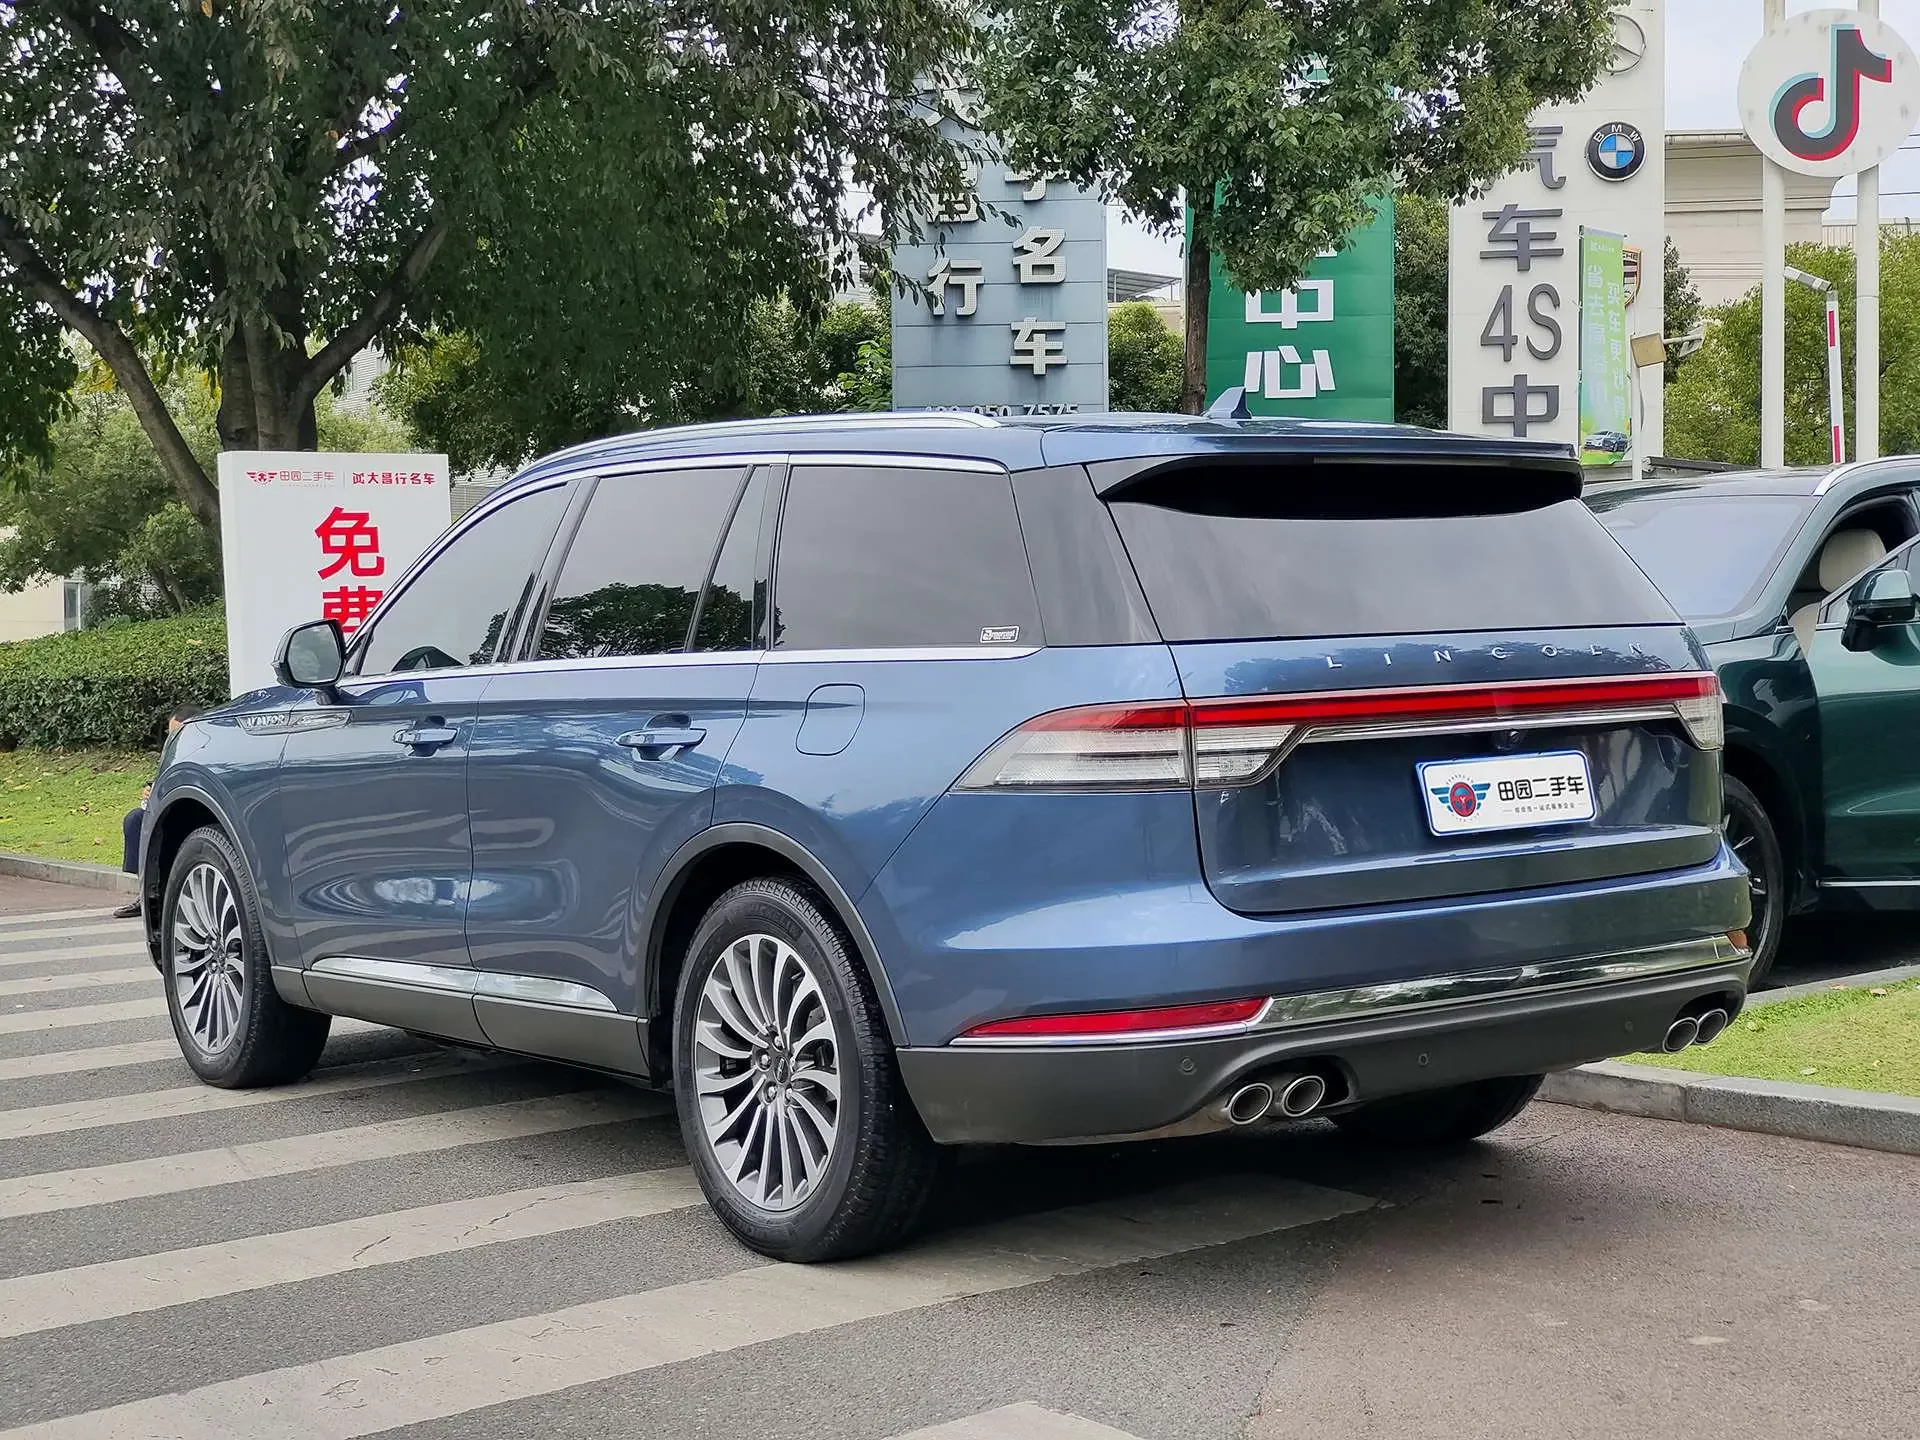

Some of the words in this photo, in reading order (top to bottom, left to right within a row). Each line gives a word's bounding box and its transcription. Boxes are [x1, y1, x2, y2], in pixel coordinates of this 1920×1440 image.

[1593, 124, 1641, 142] BMW
[367, 472, 436, 485] 大昌行名车
[1327, 641, 1643, 668] LINCOLN
[1498, 776, 1584, 801] 田园二手车
